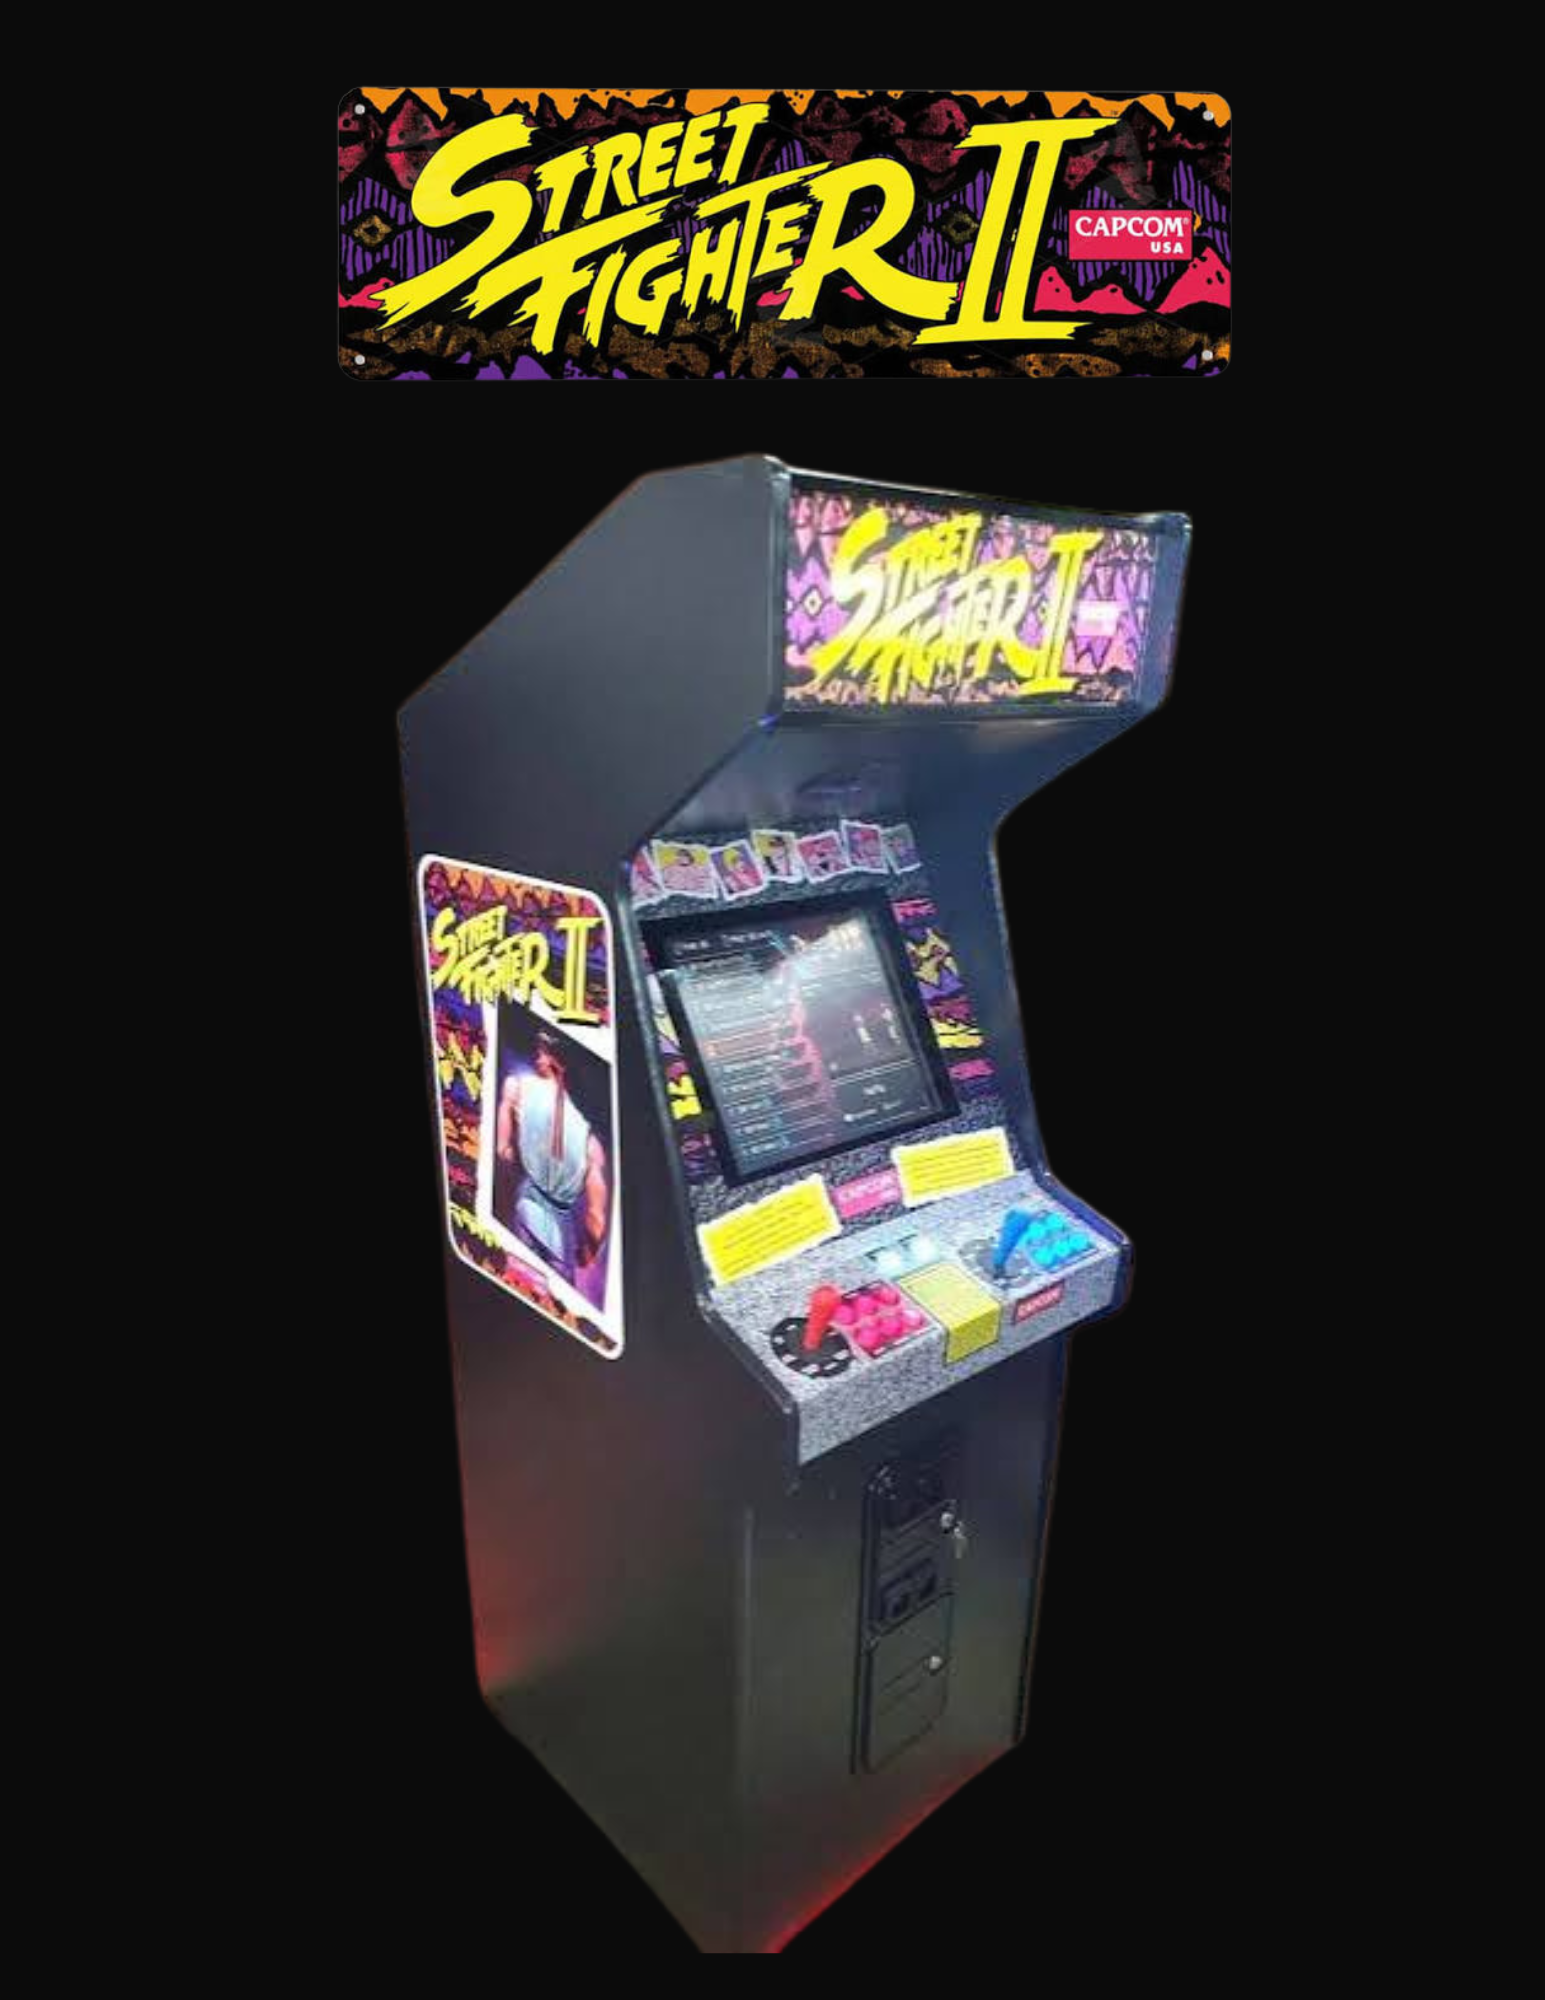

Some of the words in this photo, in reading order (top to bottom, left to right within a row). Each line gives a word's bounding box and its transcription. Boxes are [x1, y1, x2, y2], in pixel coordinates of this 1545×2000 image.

[369, 103, 770, 331] STREET
[452, 158, 959, 355] FIGHTER
[912, 118, 1121, 345] II
[1151, 242, 1183, 253] USA
[1019, 532, 1104, 694] II
[556, 917, 604, 1020] II
